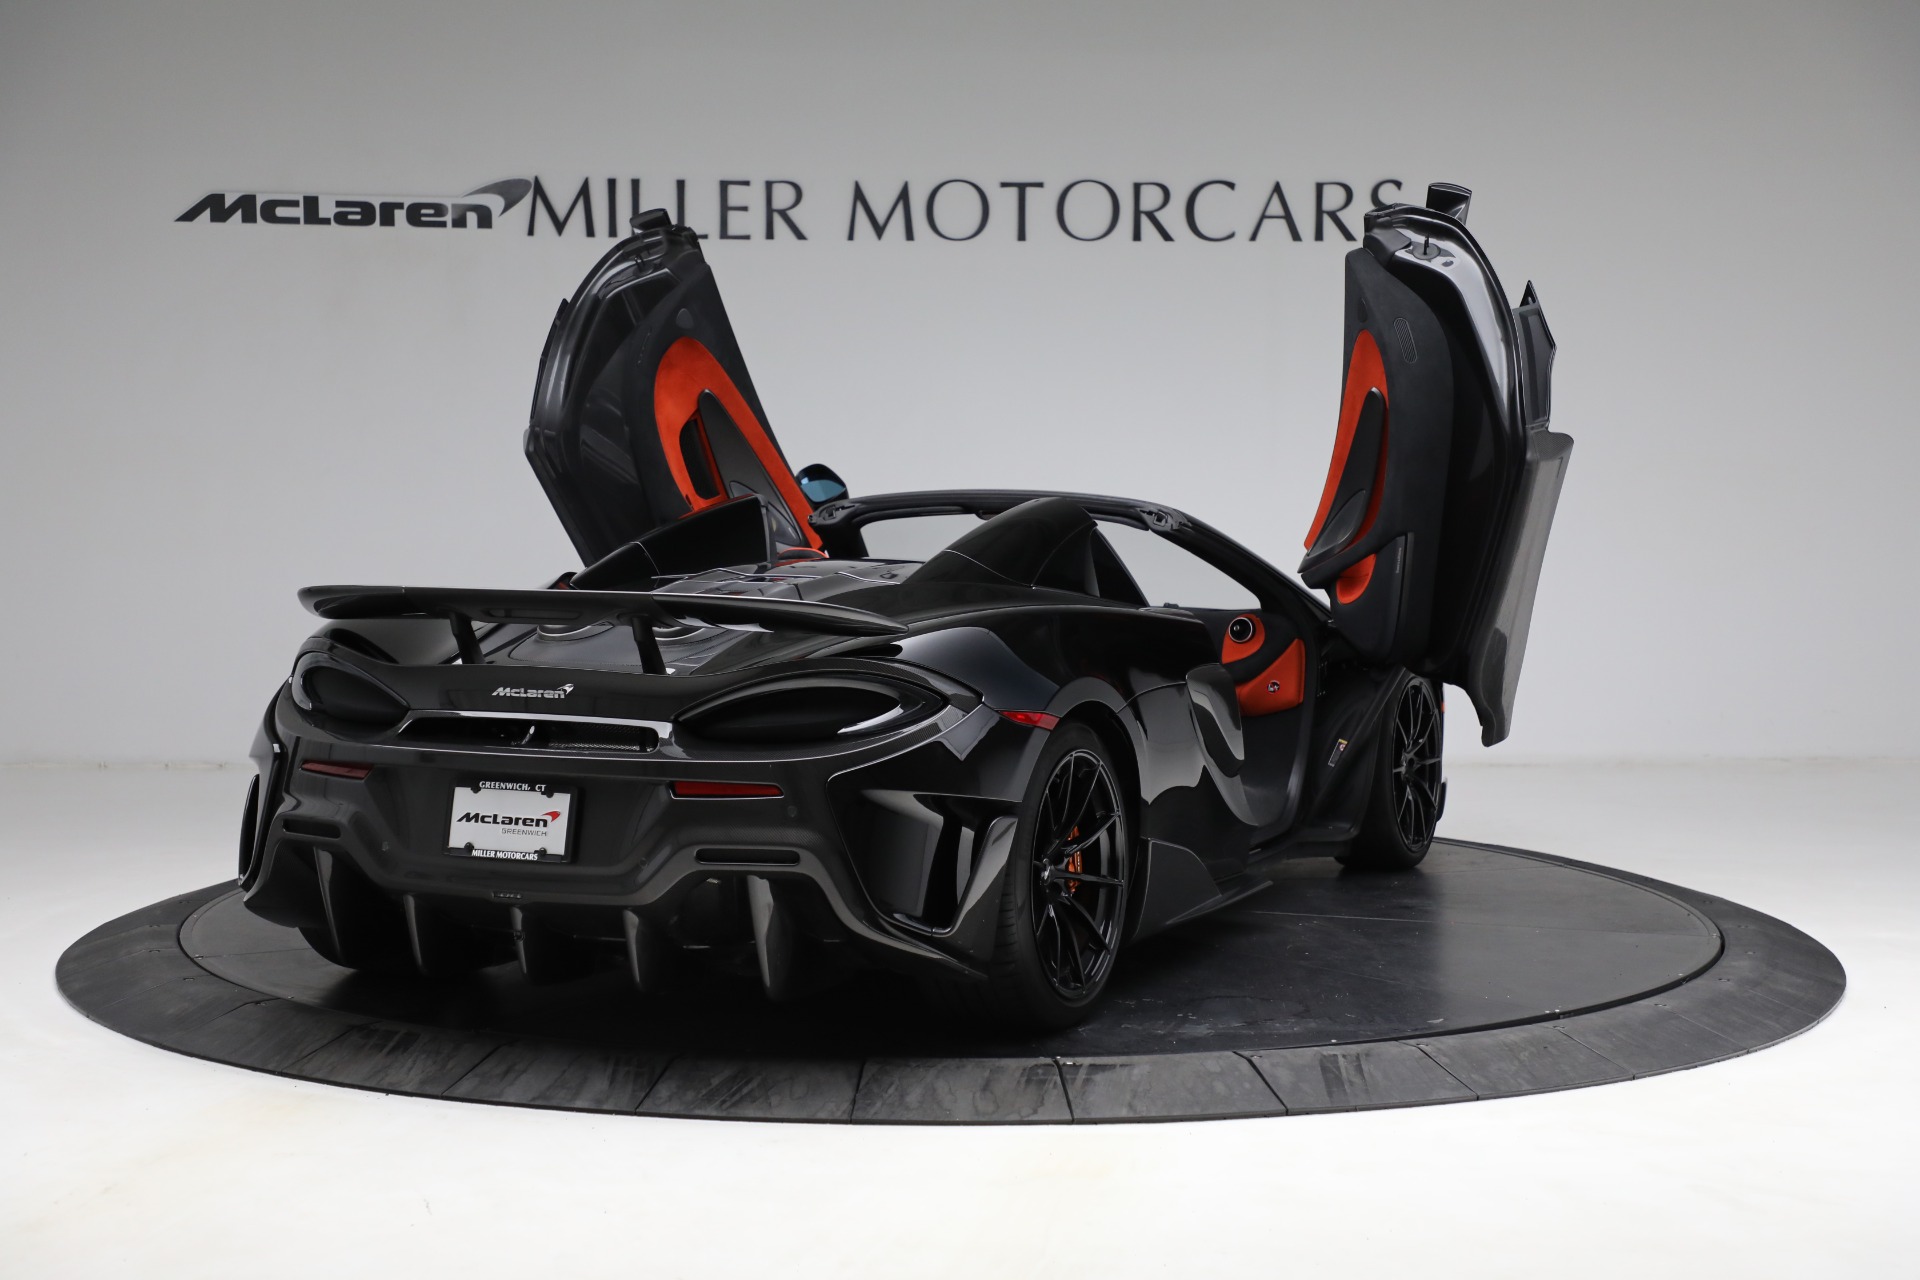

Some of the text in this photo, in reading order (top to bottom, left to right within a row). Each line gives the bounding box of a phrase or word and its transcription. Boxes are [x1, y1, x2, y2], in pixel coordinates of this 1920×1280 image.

[174, 192, 493, 229] McLaren
[491, 686, 565, 699] McLaren
[535, 784, 547, 792] CT
[456, 811, 548, 828] McLaren
[501, 827, 548, 837] GREENWICH
[471, 849, 539, 861] MILLER MOTORCARS
